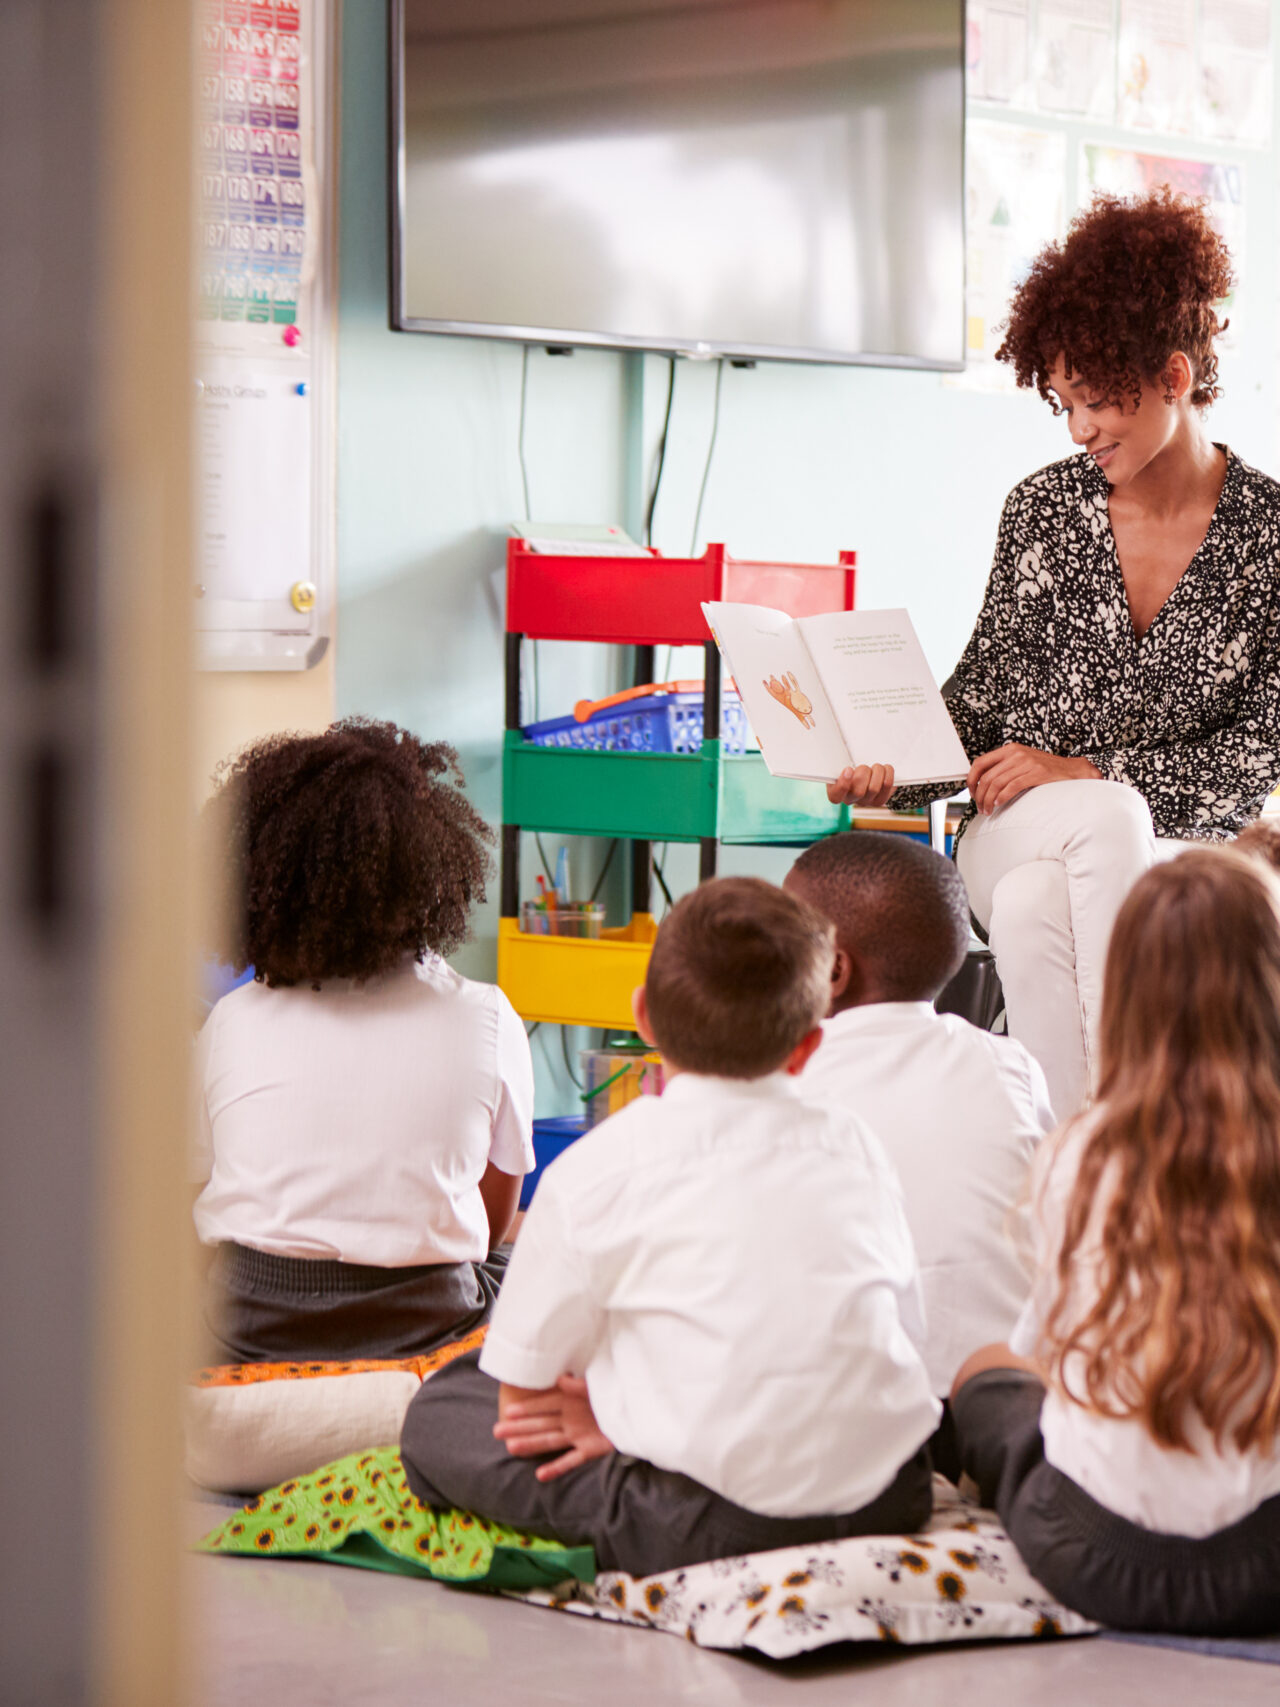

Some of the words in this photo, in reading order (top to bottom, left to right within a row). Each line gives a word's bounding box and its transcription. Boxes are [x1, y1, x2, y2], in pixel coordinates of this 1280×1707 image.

[224, 28, 248, 53] 148
[249, 31, 274, 57] 149
[224, 79, 246, 103] 158
[249, 82, 274, 105] 159
[224, 127, 247, 152] 168
[250, 131, 274, 155] 169
[227, 177, 250, 201] 178
[252, 179, 277, 204] 179
[228, 225, 250, 250] 188
